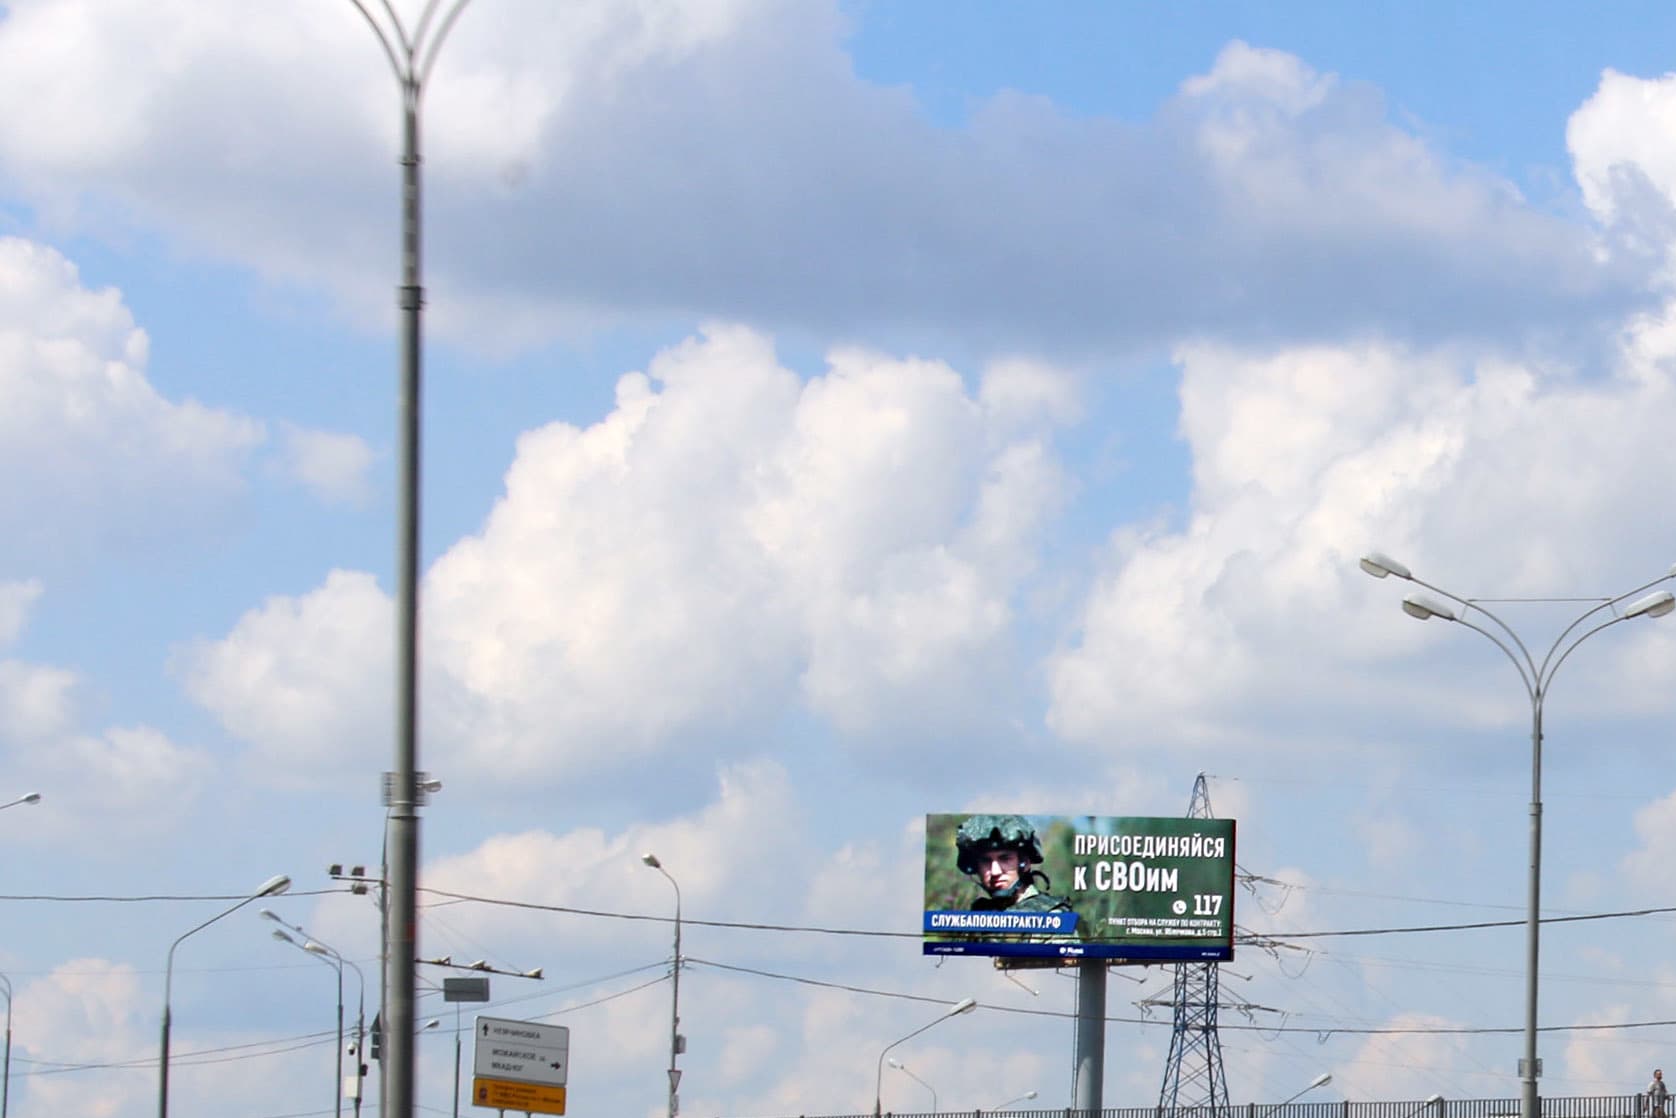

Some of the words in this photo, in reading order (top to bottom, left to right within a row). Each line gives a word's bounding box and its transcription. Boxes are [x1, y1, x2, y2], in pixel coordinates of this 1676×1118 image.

[1074, 833, 1225, 859] ПРИСОЕДИНЯЙСЯ
[1095, 860, 1178, 892] СВОим
[1193, 894, 1223, 916] 117
[931, 914, 1062, 929] СЛУЖБАПОКОНТРАКТУ.РФ
